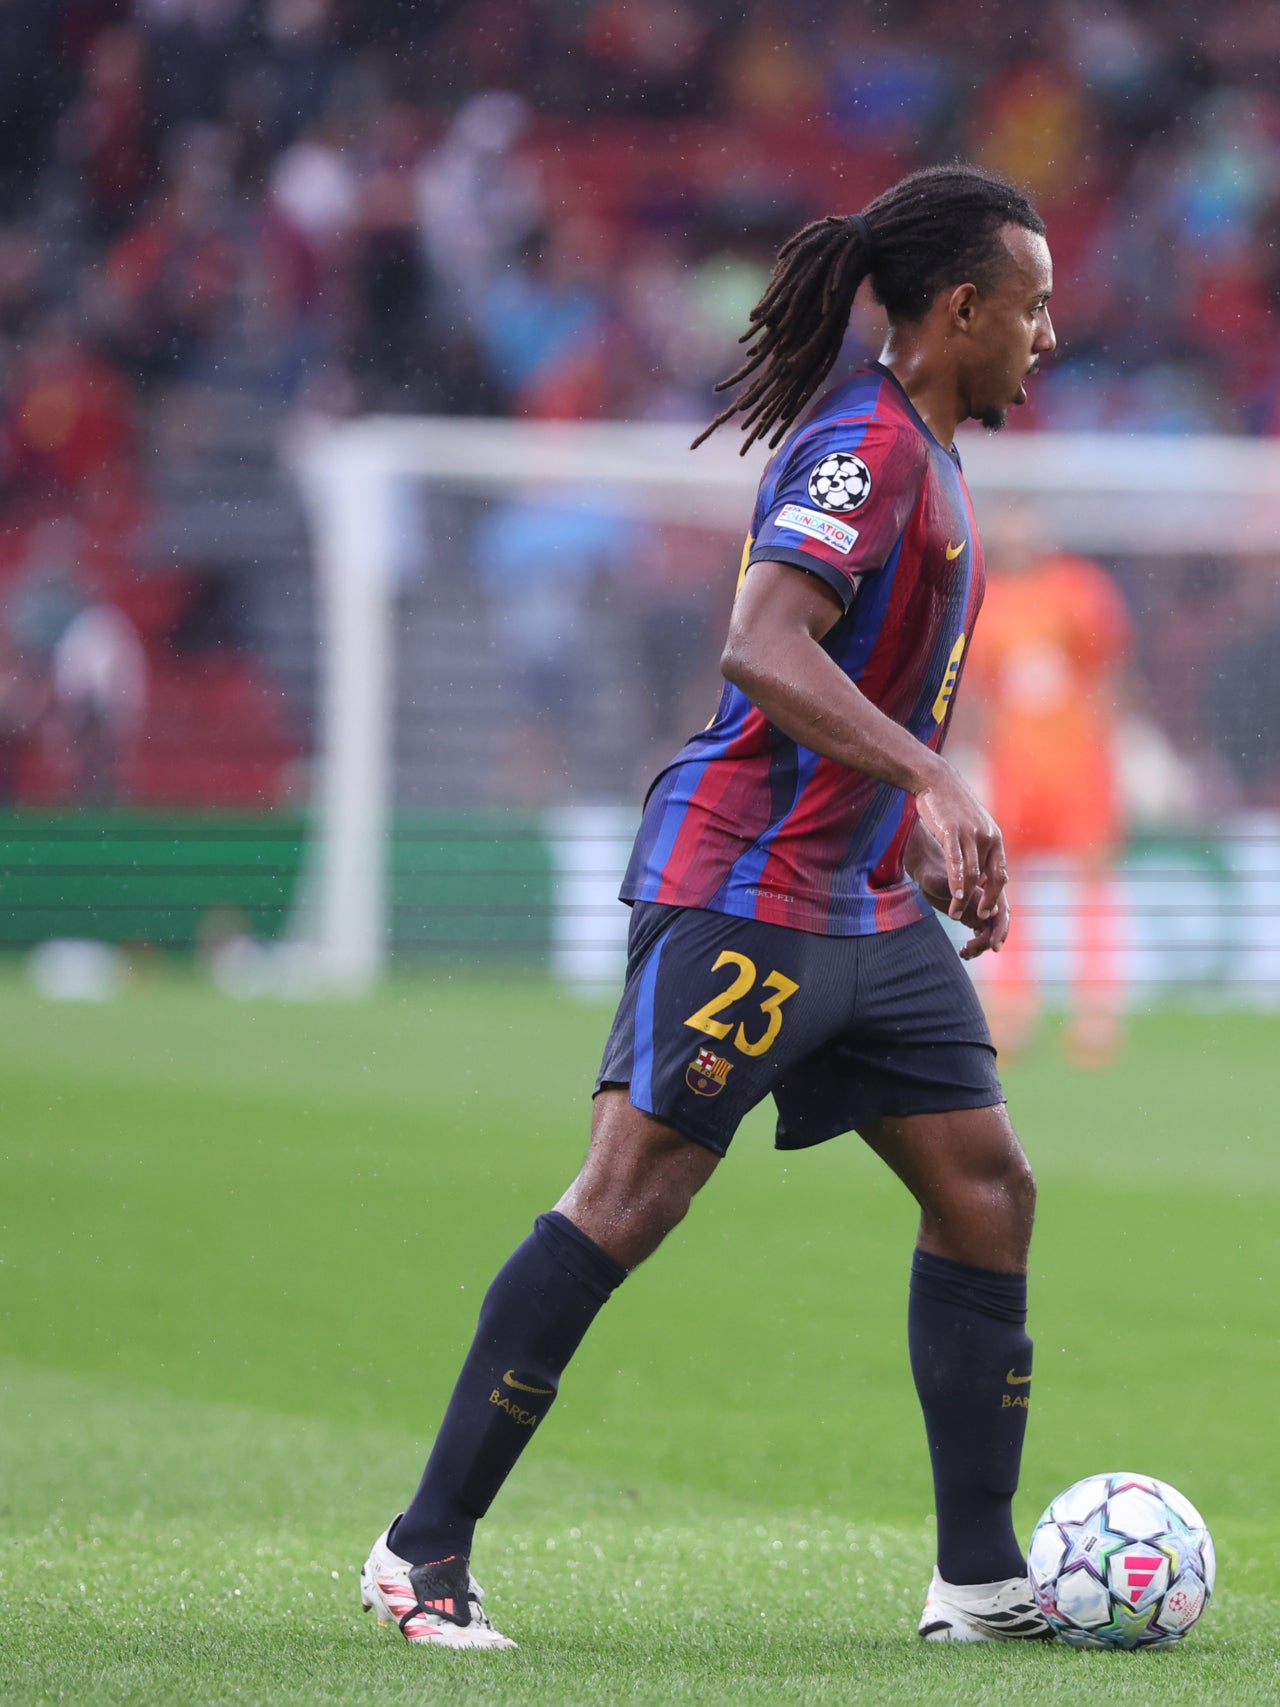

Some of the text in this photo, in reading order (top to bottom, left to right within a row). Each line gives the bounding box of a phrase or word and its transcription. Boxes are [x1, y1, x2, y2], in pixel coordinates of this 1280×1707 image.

[828, 470, 849, 492] 5
[780, 510, 853, 546] FOUNDATION
[683, 950, 800, 1057] 23
